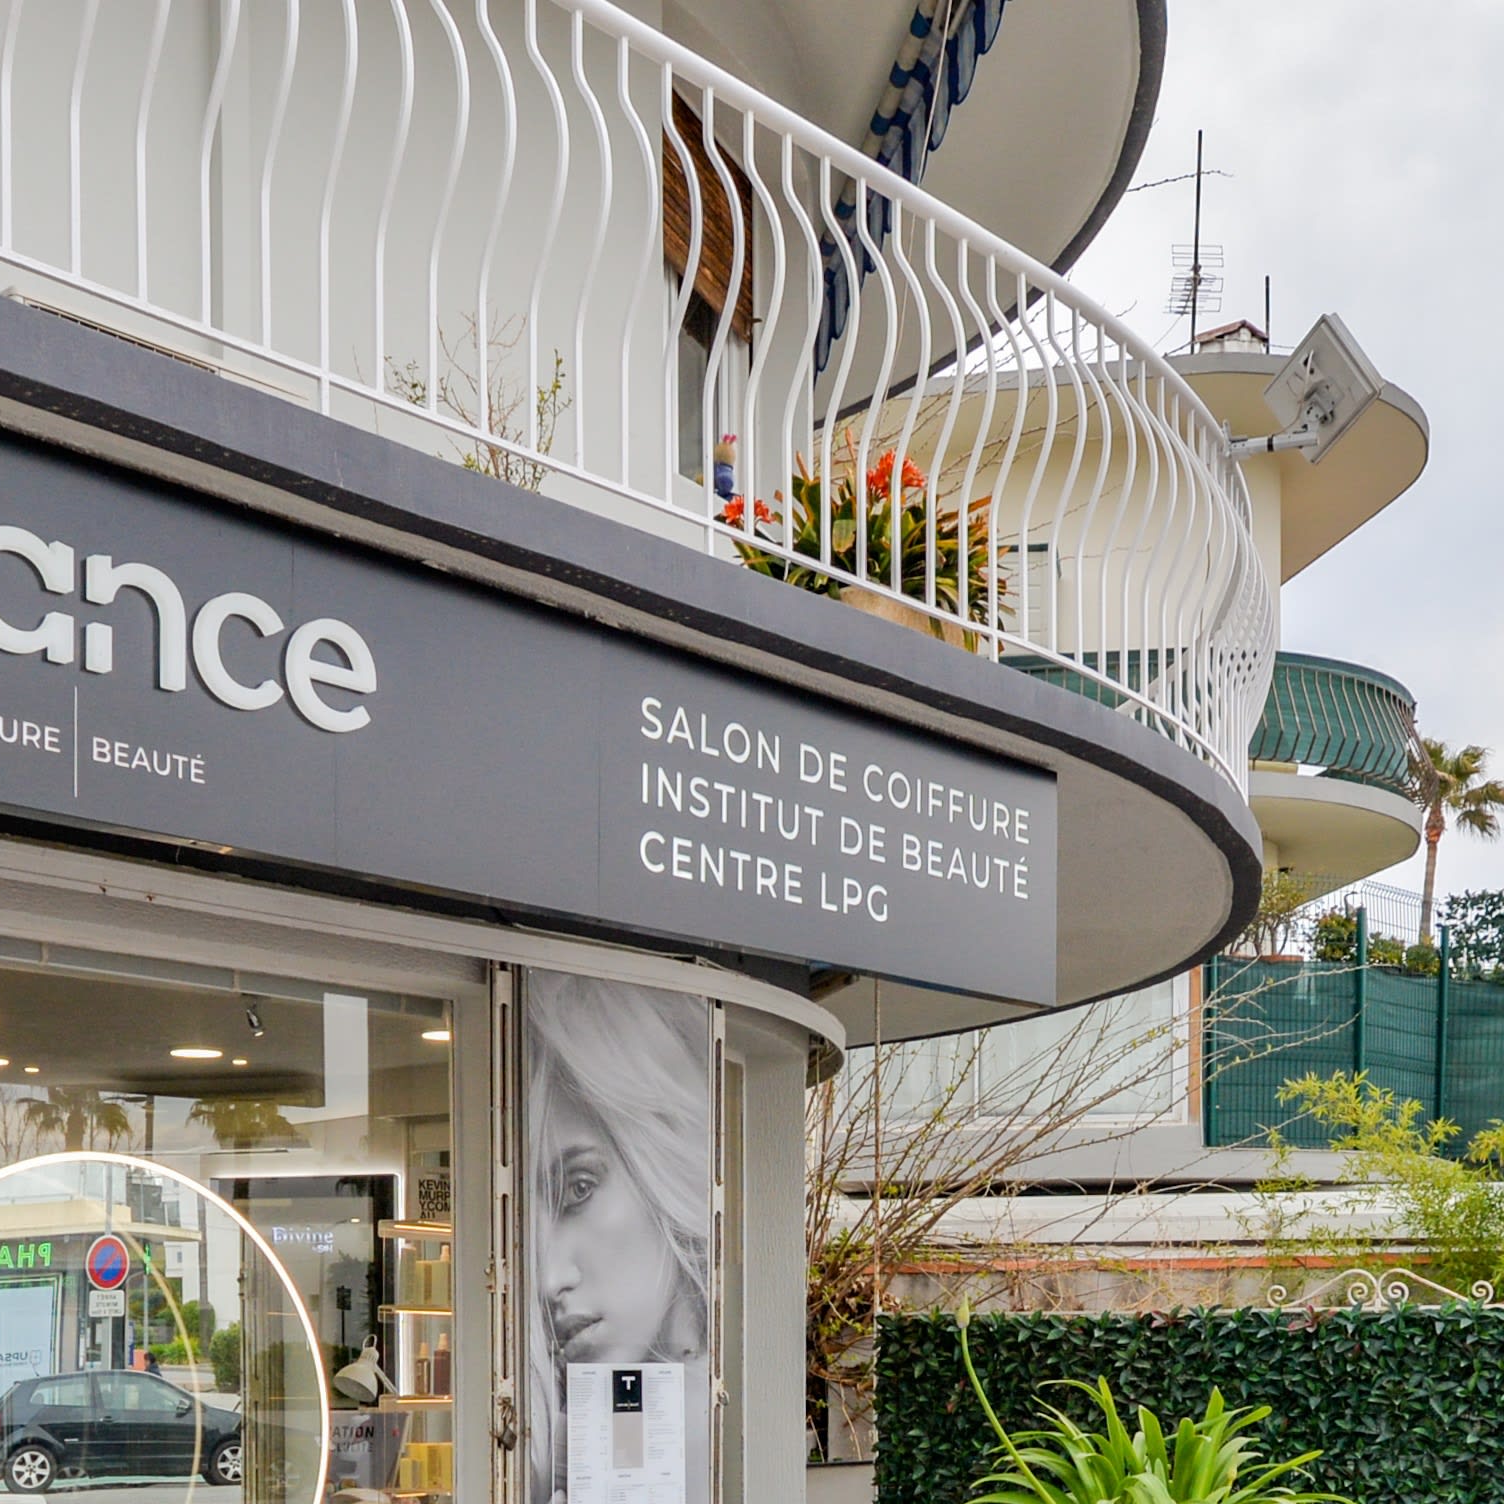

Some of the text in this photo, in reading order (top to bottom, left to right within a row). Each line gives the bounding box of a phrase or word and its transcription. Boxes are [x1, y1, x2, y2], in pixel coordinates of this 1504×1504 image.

[92, 736, 207, 784] BEAUTÉ
[640, 696, 1031, 845] SALON DE COIFFURE
[639, 830, 889, 922] CENTRE LPG
[641, 762, 1030, 900] INSTITUT DE BEAUTÉ
[621, 1375, 636, 1391] T
